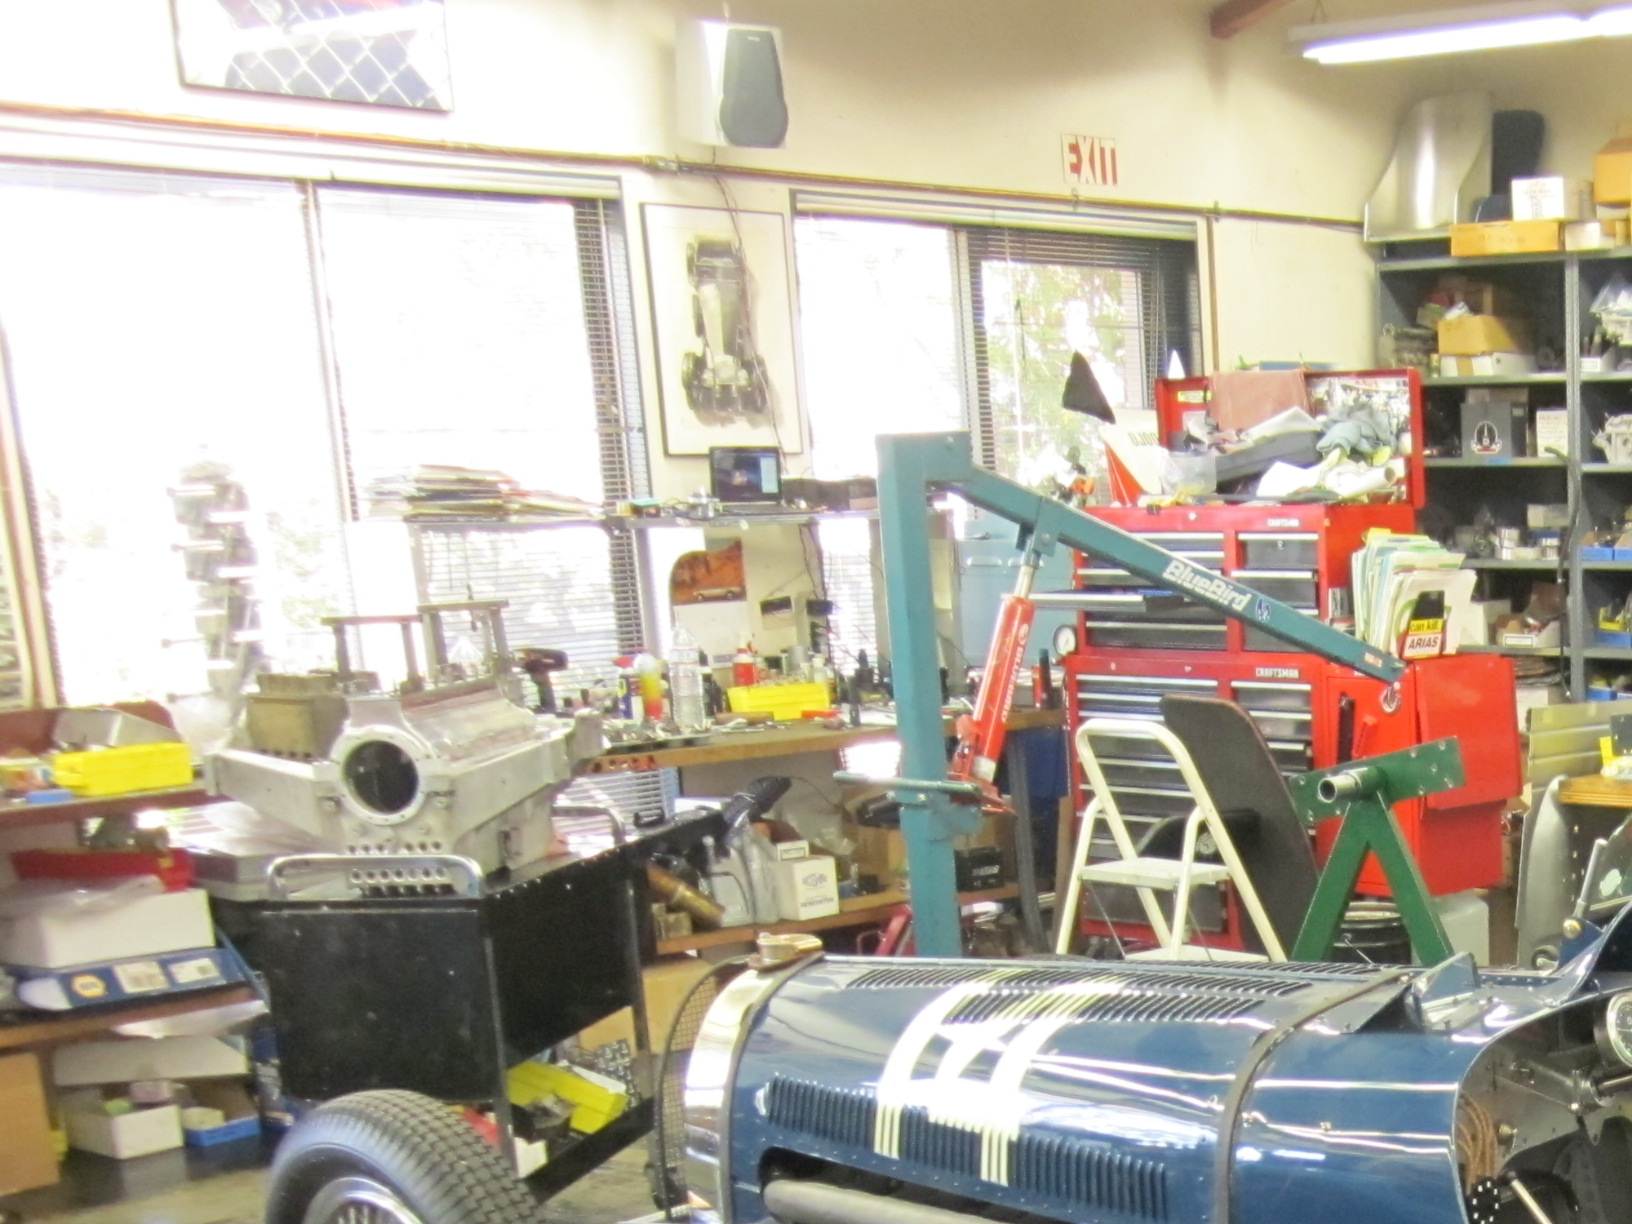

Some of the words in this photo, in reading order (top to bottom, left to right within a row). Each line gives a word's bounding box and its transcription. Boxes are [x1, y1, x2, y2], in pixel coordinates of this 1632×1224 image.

[1062, 134, 1118, 187] EXIT
[1162, 559, 1253, 612] BlueBird
[1408, 636, 1438, 650] ARIAS
[1255, 667, 1299, 678] CRAFTSMAN
